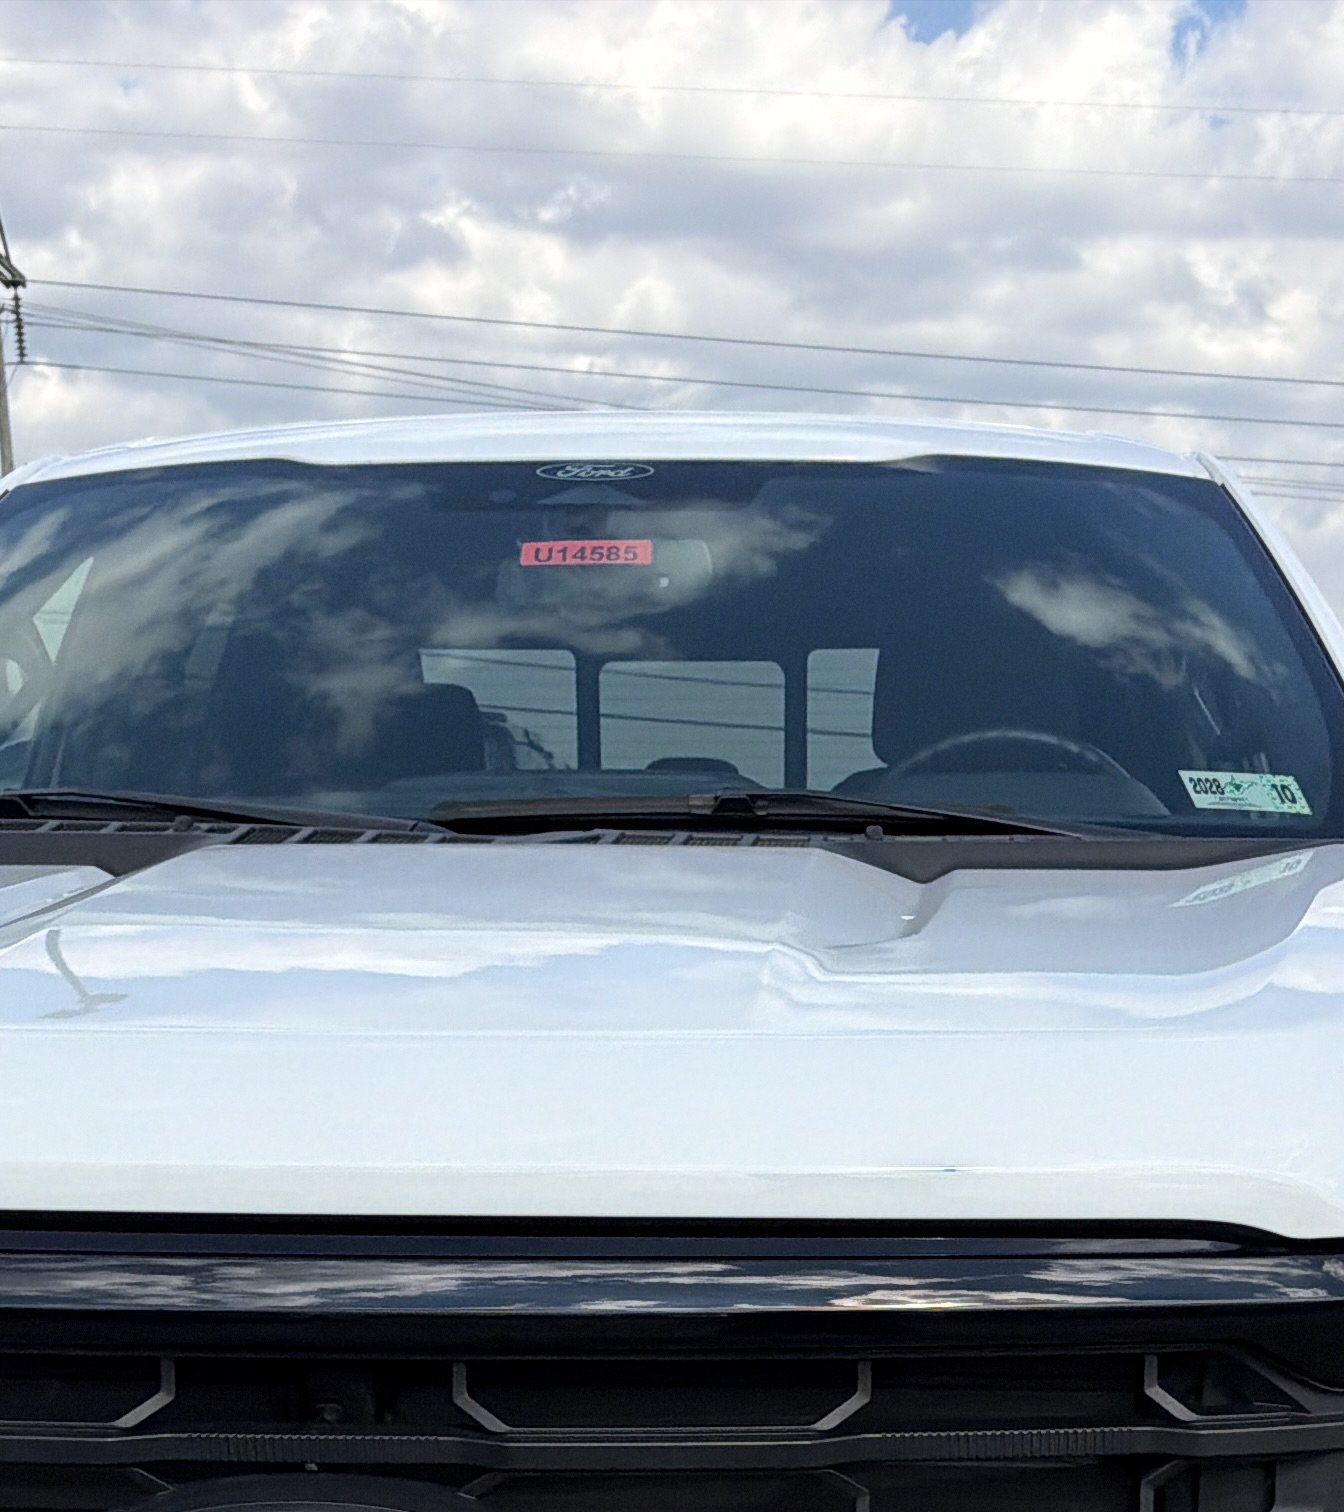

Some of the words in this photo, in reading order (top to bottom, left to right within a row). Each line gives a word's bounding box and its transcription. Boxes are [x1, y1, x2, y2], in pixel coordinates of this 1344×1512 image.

[557, 464, 633, 478] Ford
[534, 545, 639, 563] U14585
[1270, 783, 1298, 805] 10
